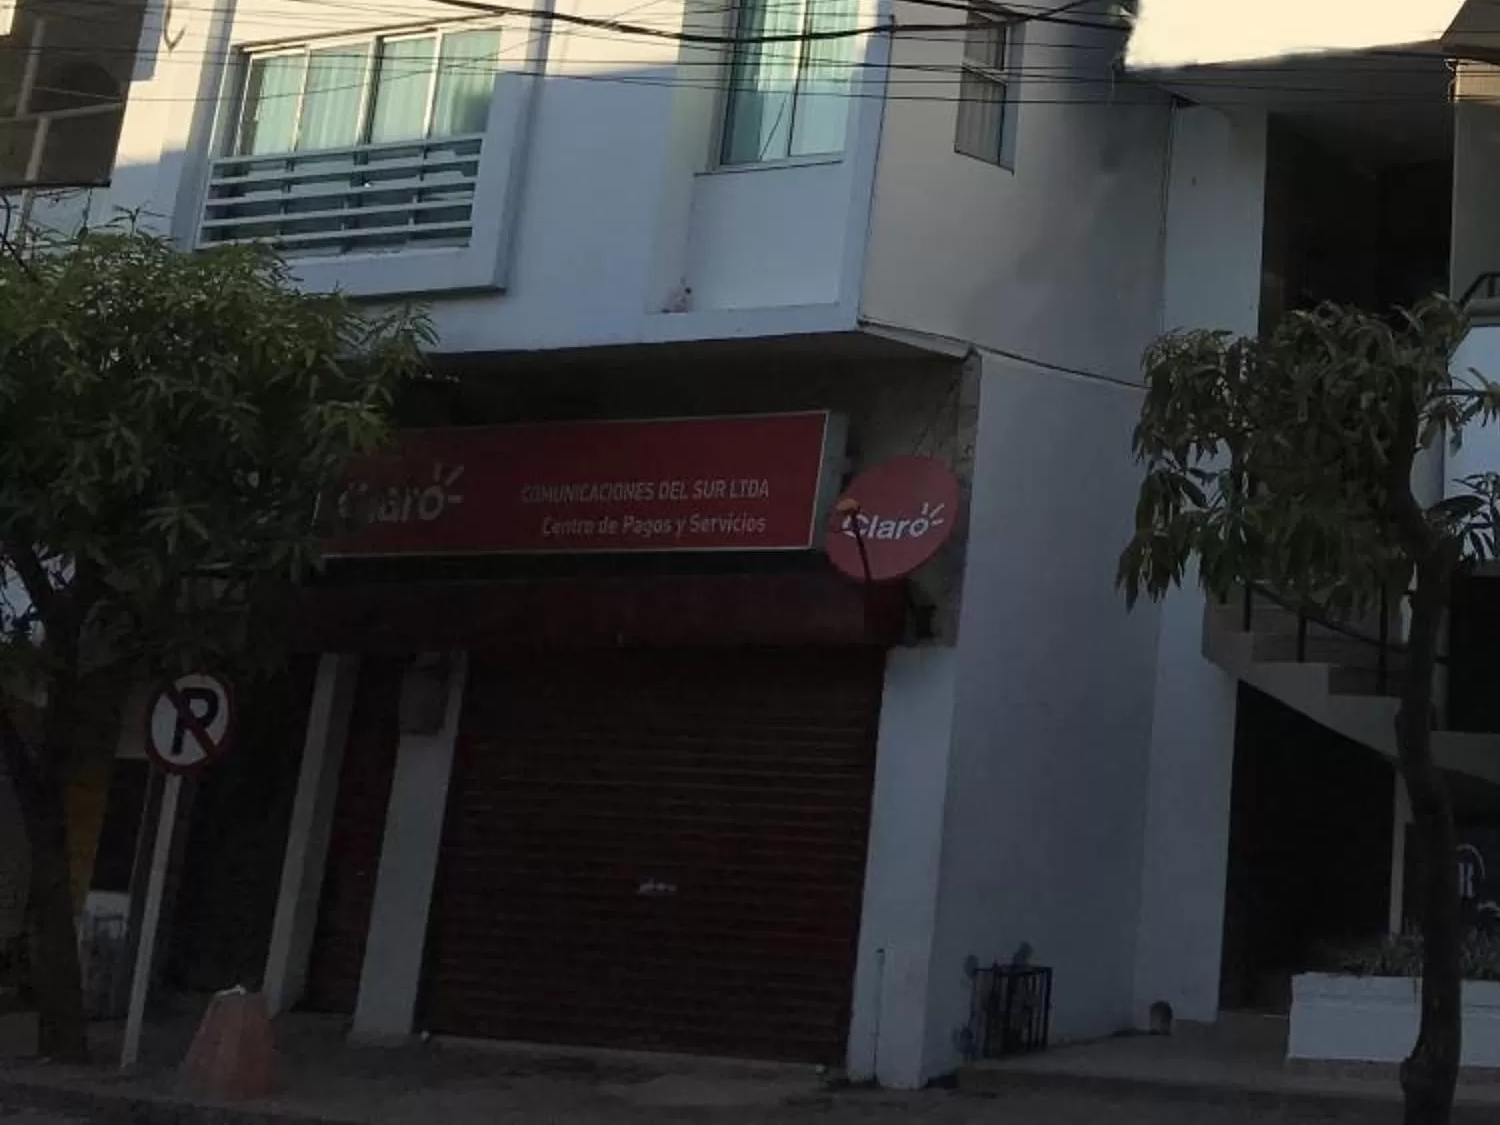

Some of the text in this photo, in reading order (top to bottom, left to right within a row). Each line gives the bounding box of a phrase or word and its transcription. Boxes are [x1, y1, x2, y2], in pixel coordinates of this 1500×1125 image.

[519, 478, 769, 504] COMUNICACIONES DEL SUR LTDA
[543, 512, 768, 539] Centro de Pagos y Servicios
[841, 508, 935, 540] Claro
[171, 687, 219, 756] P
